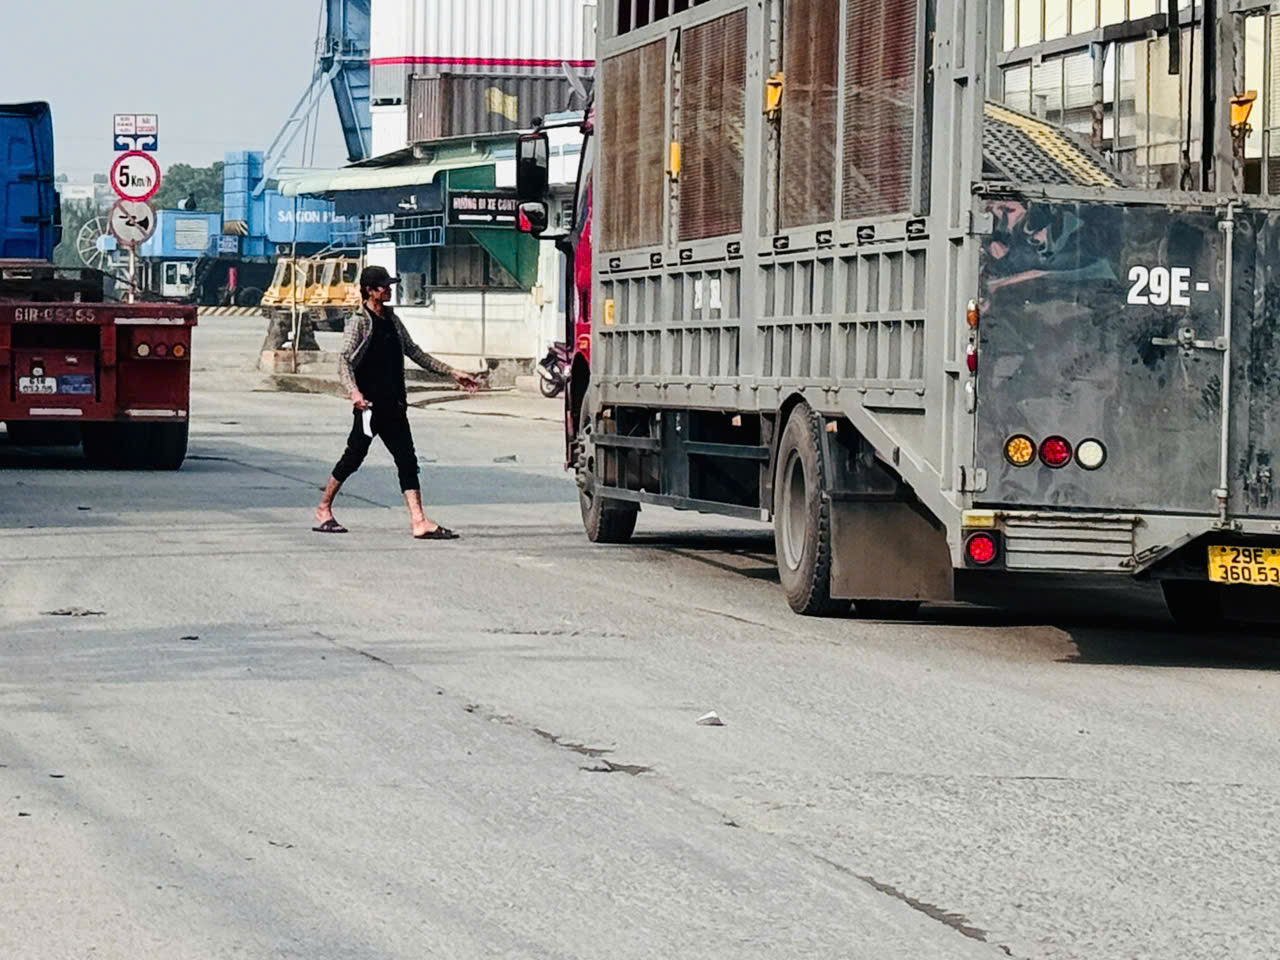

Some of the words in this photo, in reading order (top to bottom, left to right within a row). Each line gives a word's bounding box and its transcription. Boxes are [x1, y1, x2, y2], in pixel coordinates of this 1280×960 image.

[119, 165, 130, 187] 5
[1230, 547, 1264, 564] 29E
[1219, 564, 1280, 583] 360.53
